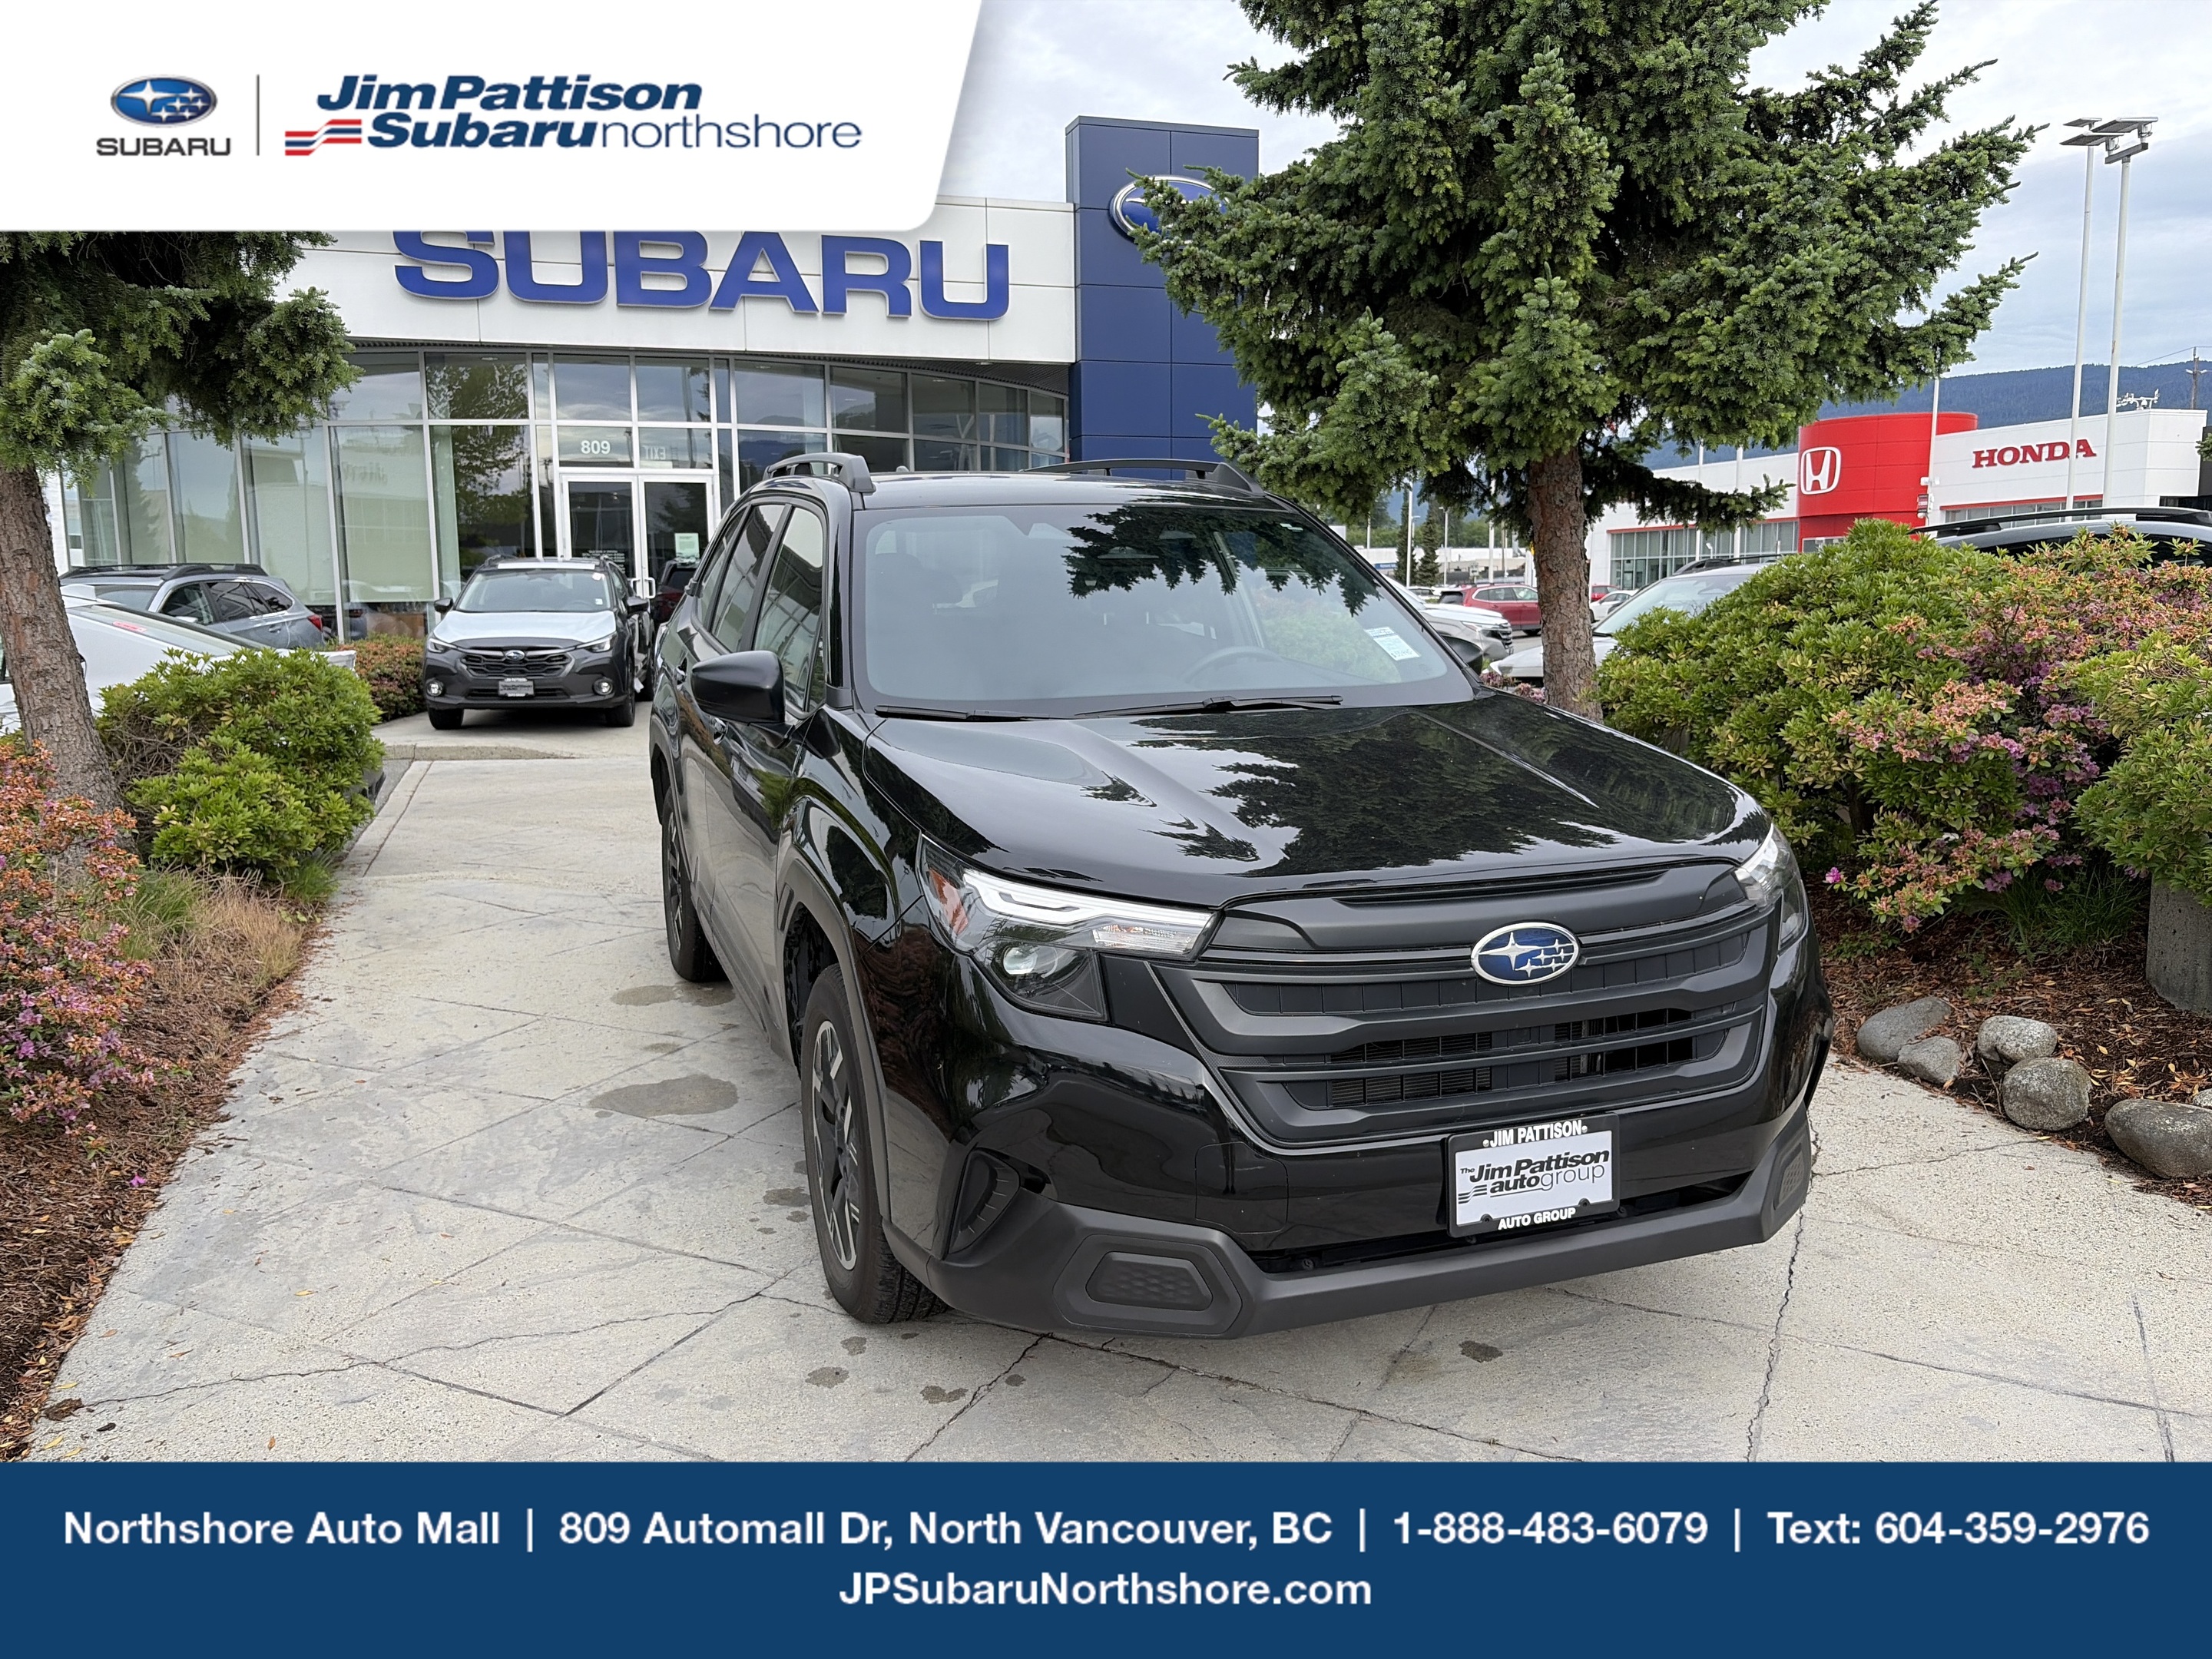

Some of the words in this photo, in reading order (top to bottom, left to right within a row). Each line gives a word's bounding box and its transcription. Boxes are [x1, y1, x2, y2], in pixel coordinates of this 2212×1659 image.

[394, 230, 1010, 320] SUBARU
[581, 440, 611, 455] 809
[1972, 439, 2096, 469] HONDA
[1489, 1129, 1514, 1147] JIM
[1517, 1119, 1582, 1144] PATTISON
[1460, 1167, 1475, 1175] The
[1469, 1163, 1512, 1183] Jim
[1513, 1150, 1610, 1177] Pattison
[1498, 1214, 1532, 1230] AUTO
[1533, 1207, 1577, 1225] GROUP
